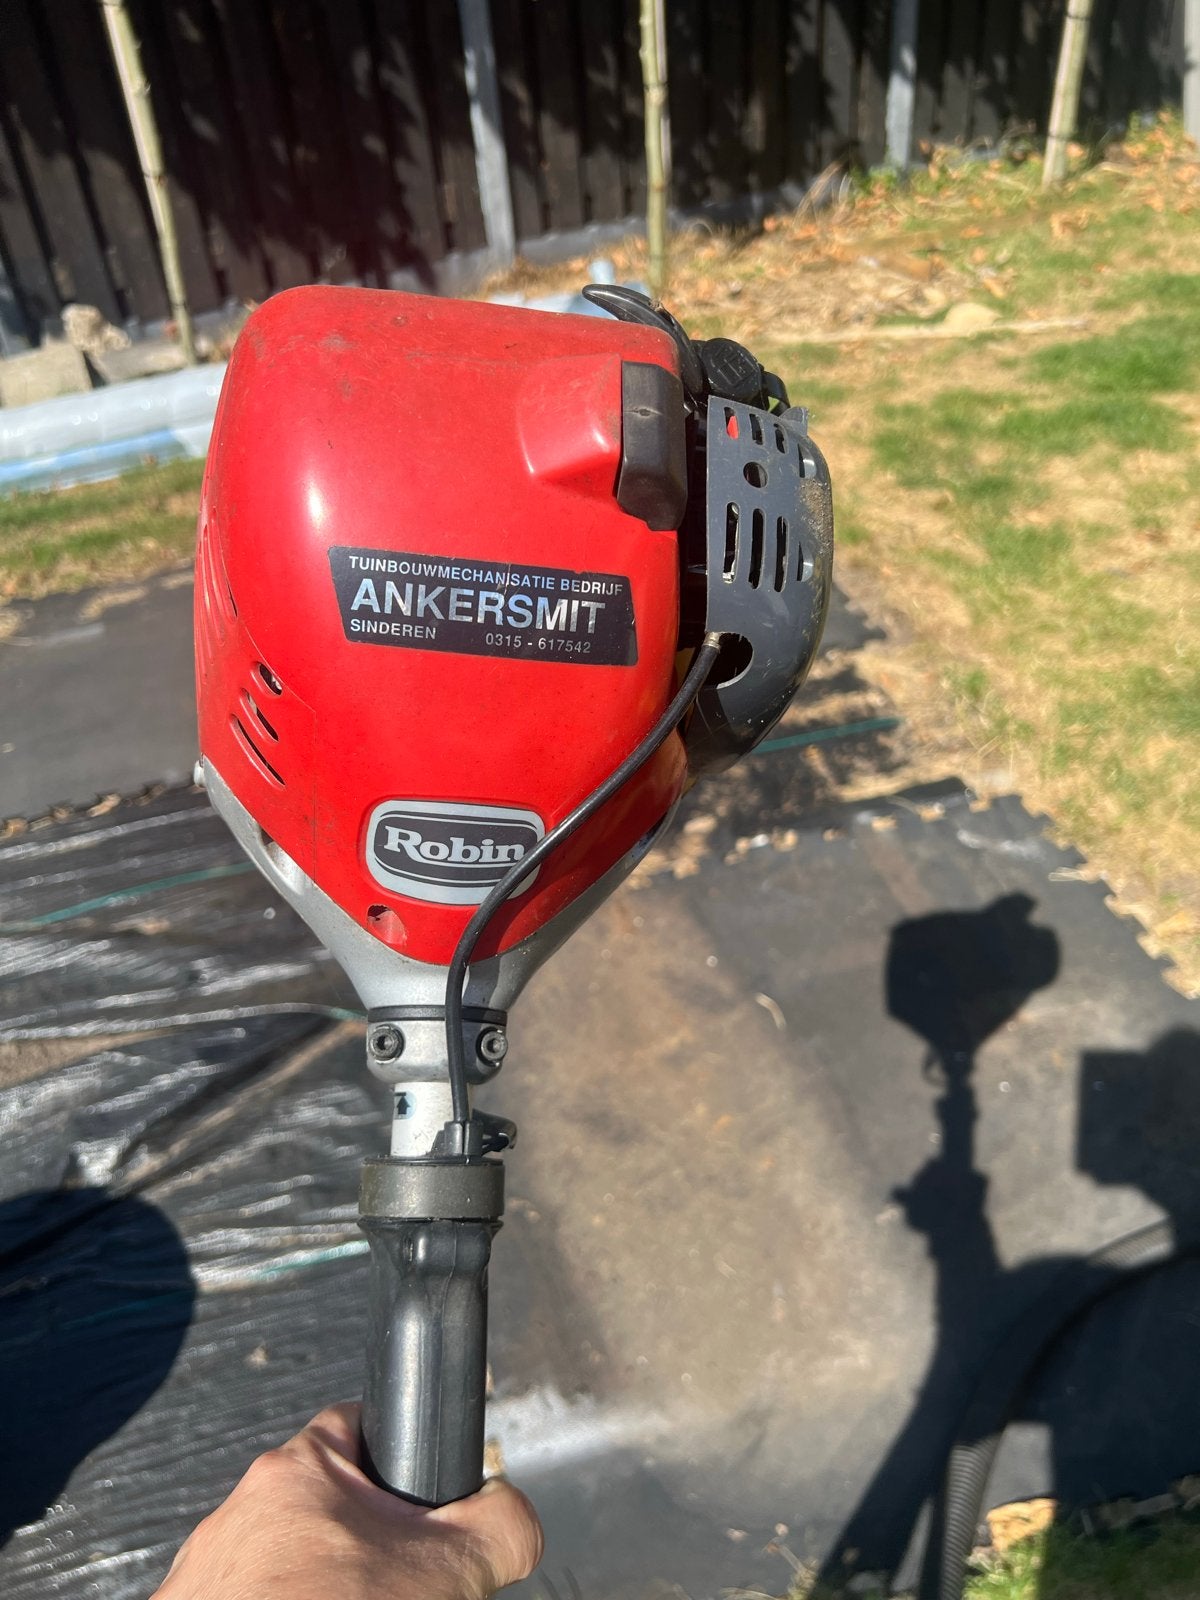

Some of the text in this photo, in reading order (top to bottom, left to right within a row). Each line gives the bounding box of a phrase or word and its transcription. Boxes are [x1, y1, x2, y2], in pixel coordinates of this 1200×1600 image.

[349, 556, 623, 596] TUINBOUWMECHANISATIE BEDRIJF
[350, 578, 606, 634] ANKERSMIT
[350, 619, 437, 640] SINDEREN
[485, 632, 522, 648] 0315
[538, 638, 592, 654] 617542
[383, 825, 526, 866] Robin
